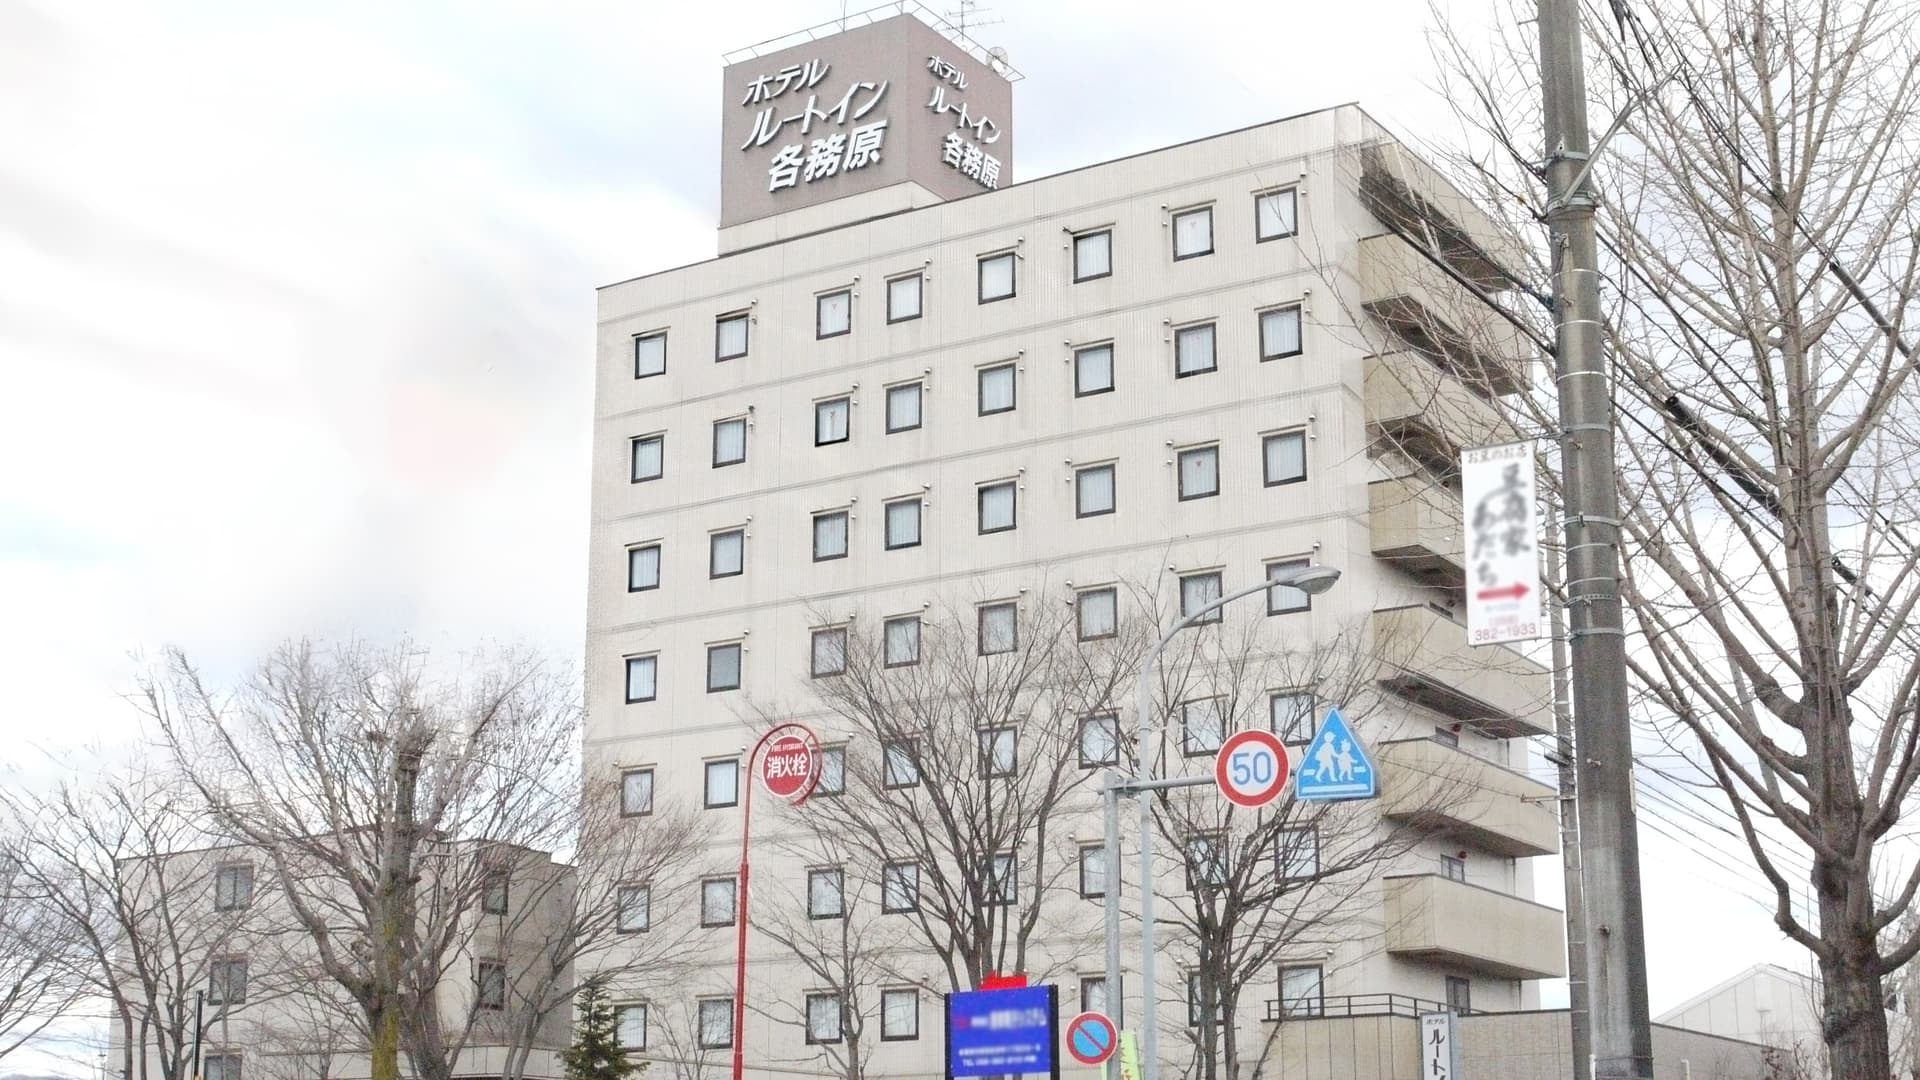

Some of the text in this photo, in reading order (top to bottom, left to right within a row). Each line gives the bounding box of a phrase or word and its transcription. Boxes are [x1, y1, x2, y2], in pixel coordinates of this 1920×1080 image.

[742, 58, 831, 106] ホテル
[927, 55, 968, 90] ホテル
[741, 80, 889, 151] ルートイン
[926, 86, 1001, 144] ルートイン
[768, 119, 888, 192] 各務原
[942, 132, 1002, 189] 各務原
[1474, 622, 1536, 641] 382-1933
[767, 753, 807, 778] 消火栓
[1233, 751, 1271, 785] 50
[1429, 1028, 1446, 1080] ルート
